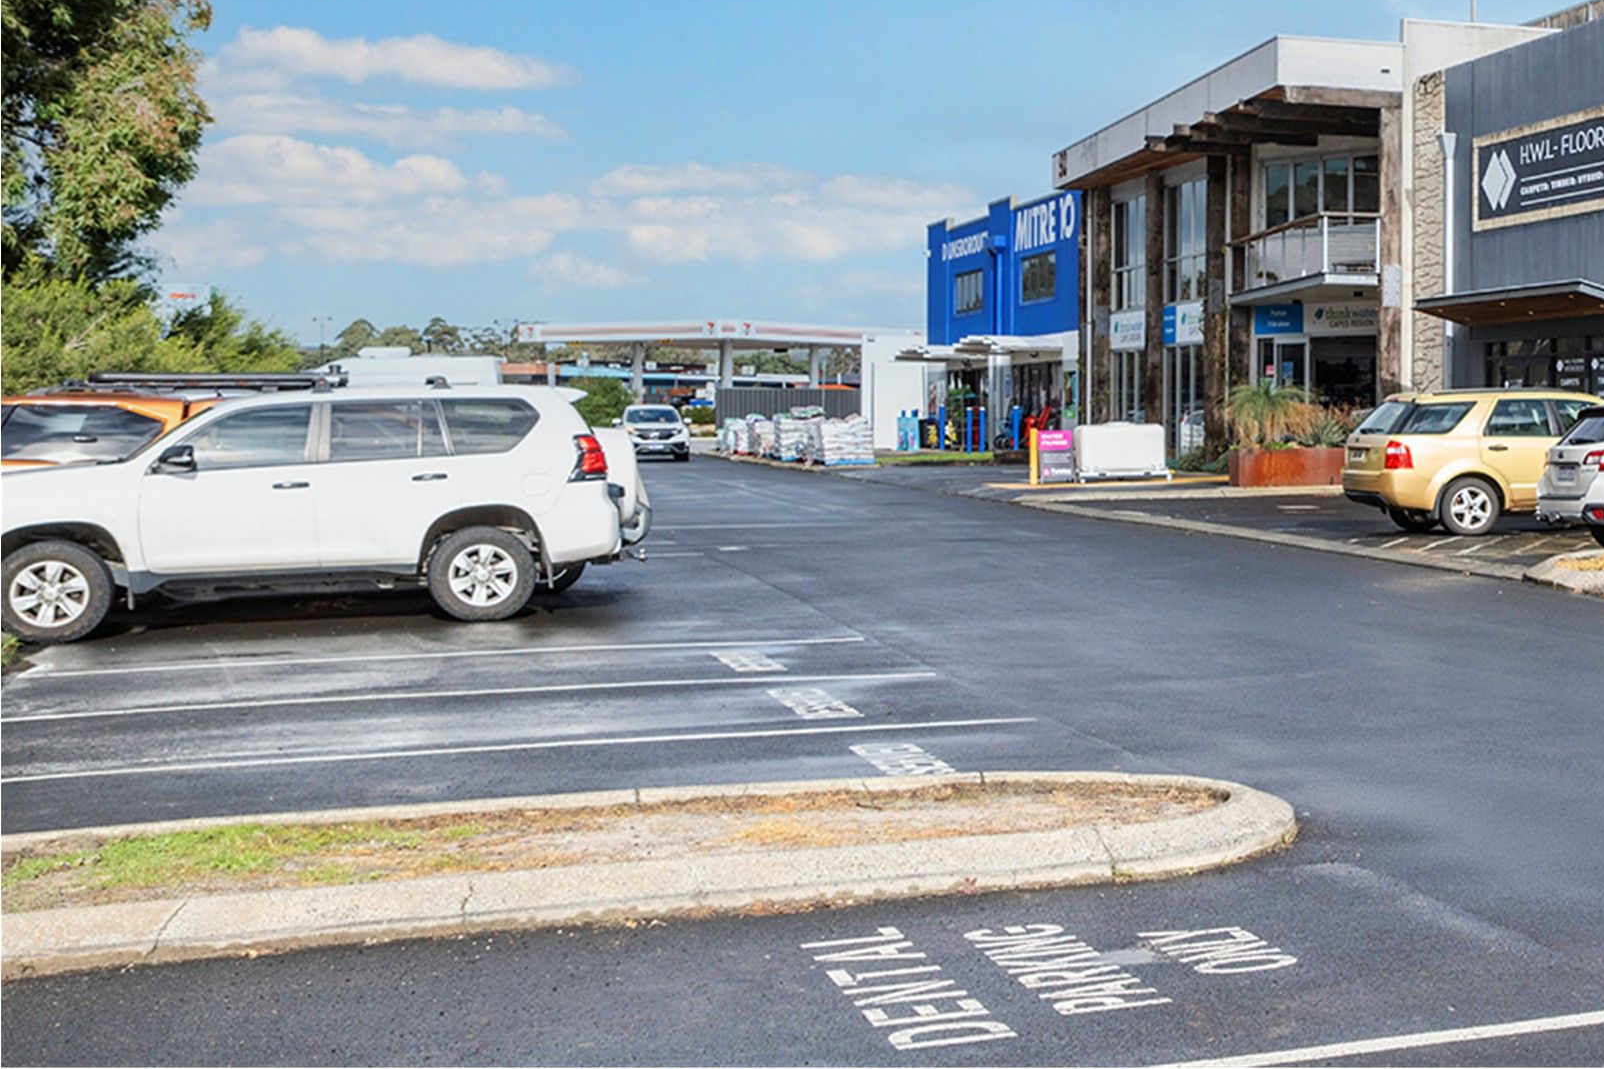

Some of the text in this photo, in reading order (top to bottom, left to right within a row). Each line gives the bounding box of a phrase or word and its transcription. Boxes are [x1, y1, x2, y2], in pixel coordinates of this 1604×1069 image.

[1014, 200, 1057, 252] MITRE
[1059, 193, 1076, 240] 10
[799, 927, 1018, 1051] DENTAL
[963, 923, 1173, 1016] PARKING
[1137, 926, 1298, 976] ONLY
